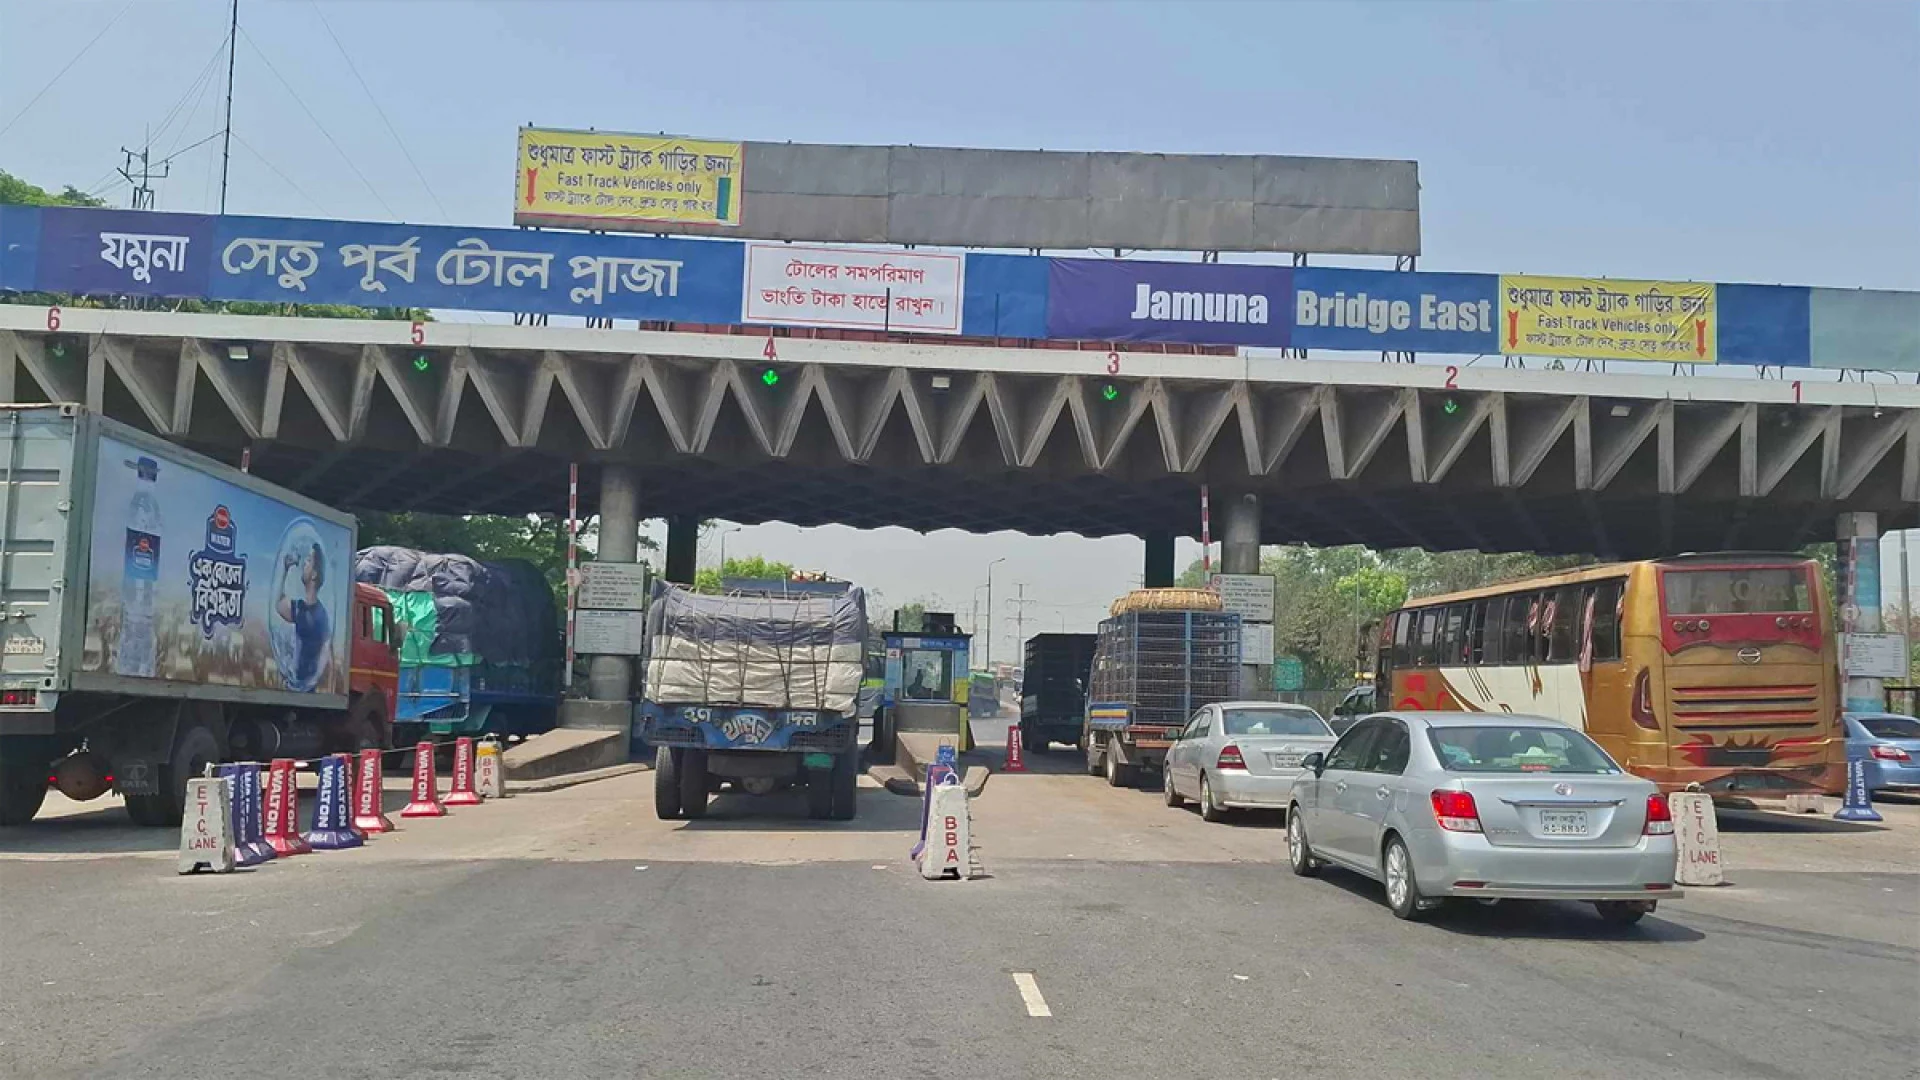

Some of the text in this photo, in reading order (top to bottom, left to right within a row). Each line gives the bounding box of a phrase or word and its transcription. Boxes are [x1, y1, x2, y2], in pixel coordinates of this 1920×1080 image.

[528, 144, 576, 168] শুধুমাত্র
[580, 144, 616, 167] ফাস্ট
[659, 146, 699, 174] গাড়ির
[704, 154, 733, 174] জন্য
[558, 171, 702, 195] Fast Track Vehicles only
[100, 232, 683, 304] যমুনা সেতু পূর্ব টোল প্লাজা
[785, 259, 925, 284] টোলের সমপরিমাণ
[760, 286, 806, 305] ভাংতি
[811, 287, 846, 308] টাকা
[852, 294, 888, 311] হাতে
[1131, 283, 1491, 333] Jamuna Bridge East
[1508, 287, 1554, 311] শুধুমাত্র
[1559, 286, 1593, 307] ফাস্ট
[1635, 287, 1674, 317] গাড়ির
[1680, 295, 1708, 315] জন্য
[47, 305, 61, 331] 6
[1537, 315, 1677, 338] Fast Track Vehicles only
[411, 322, 424, 346] 5
[763, 337, 777, 360] 4
[1107, 353, 1121, 375] 3
[1445, 366, 1458, 389] 2
[1791, 380, 1801, 403] 1
[418, 750, 429, 800] WALTON
[457, 743, 467, 789] WALTON
[318, 765, 333, 827] WALTON
[337, 765, 347, 827] WALTON
[360, 758, 375, 814] WALTON
[1855, 759, 1867, 805] WALTON
[266, 769, 284, 833] WALTON
[287, 769, 295, 832] WALTON
[1694, 800, 1704, 845] ETC
[188, 837, 217, 850] LANE
[944, 815, 958, 862] BBA
[1690, 850, 1718, 864] LANE
